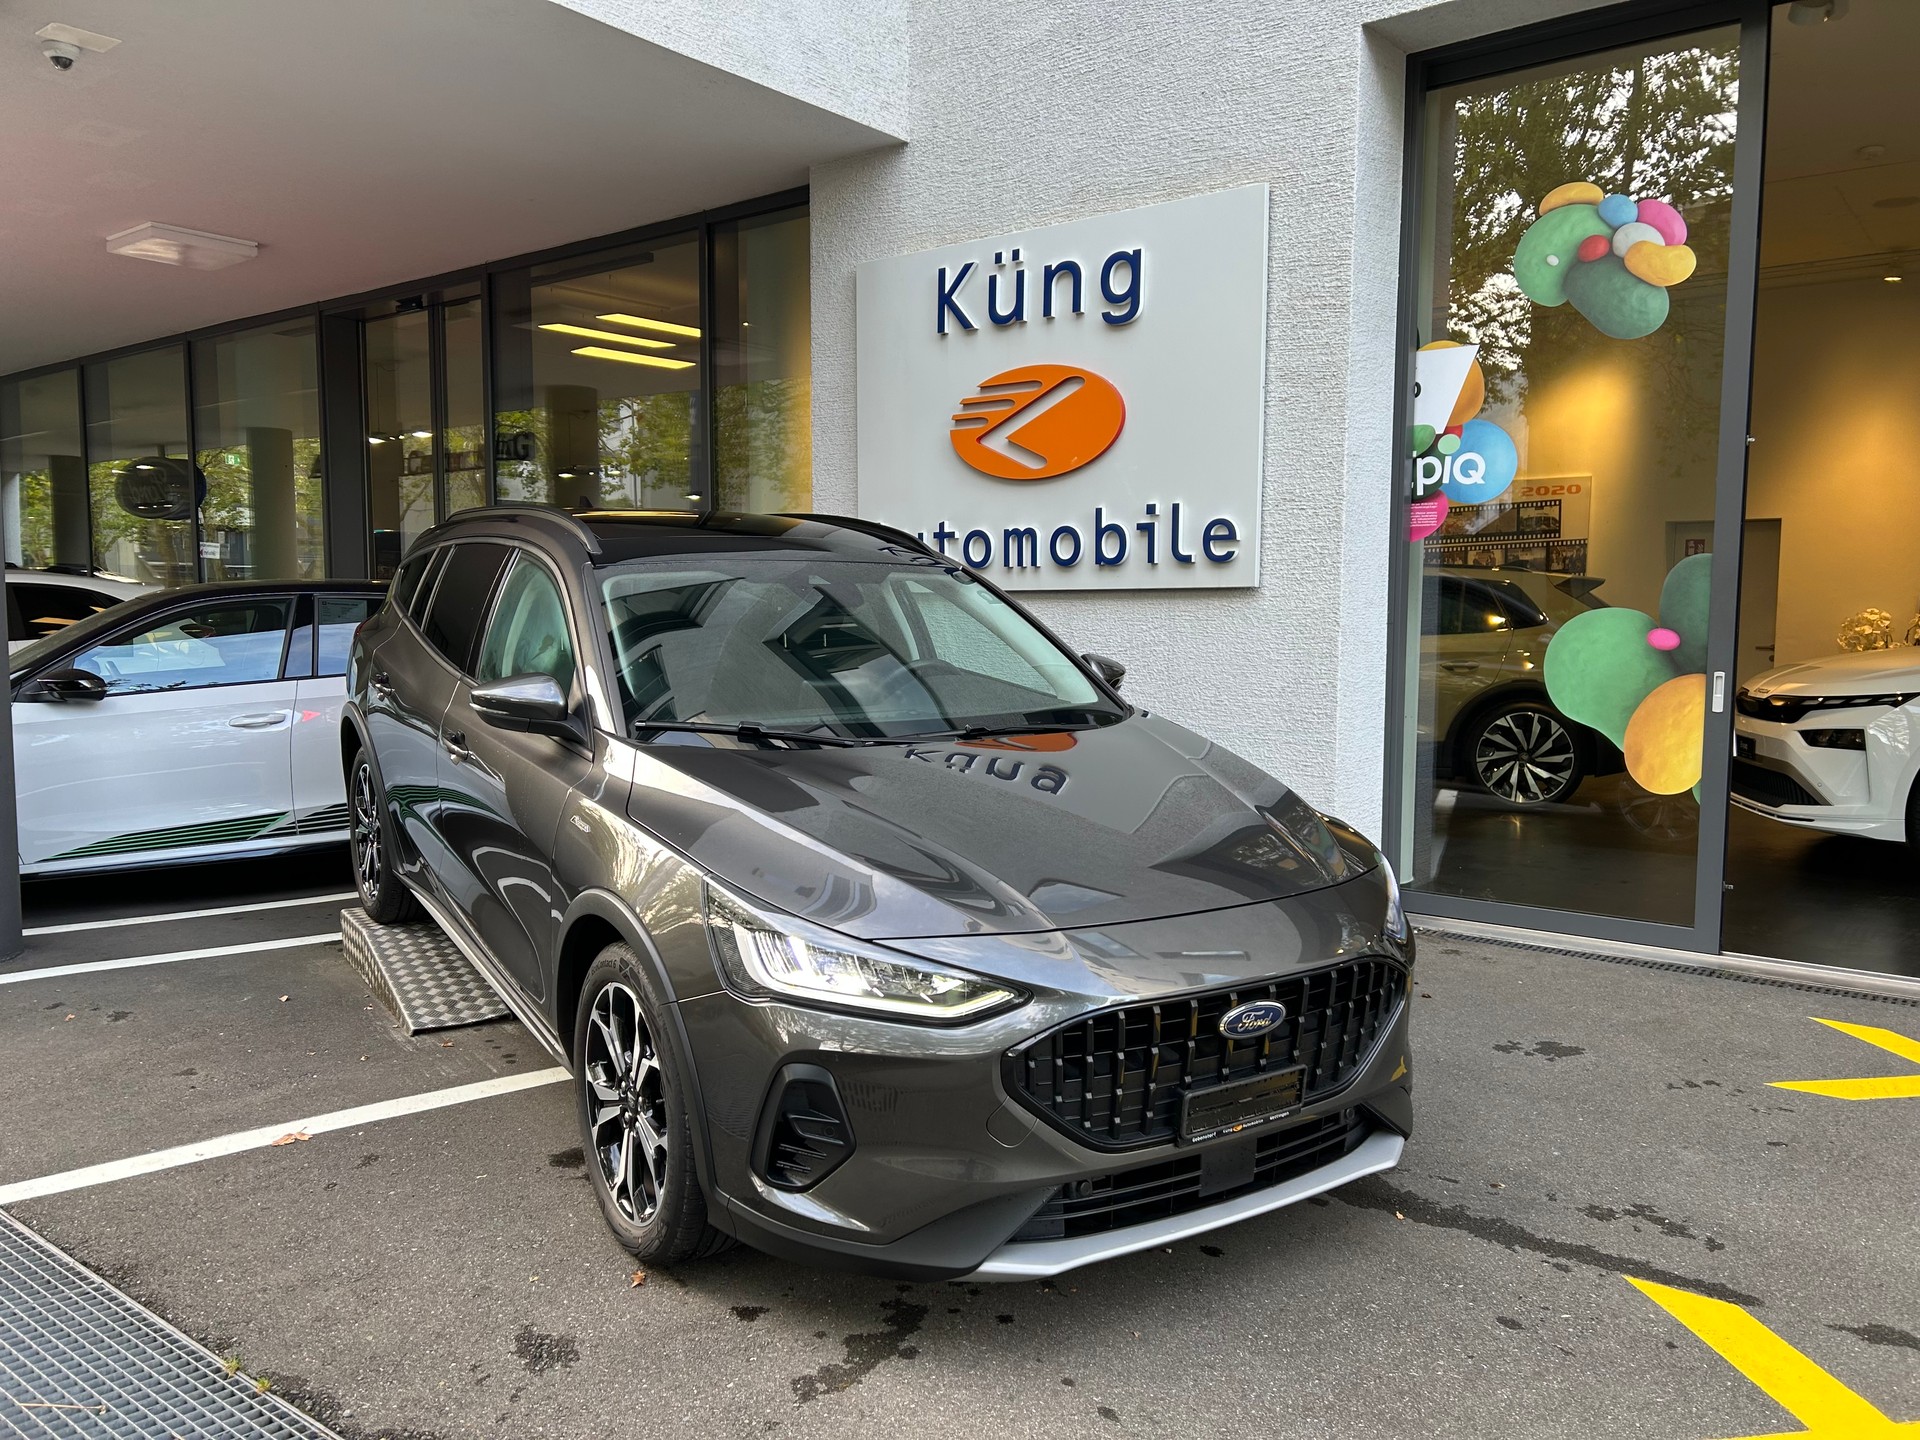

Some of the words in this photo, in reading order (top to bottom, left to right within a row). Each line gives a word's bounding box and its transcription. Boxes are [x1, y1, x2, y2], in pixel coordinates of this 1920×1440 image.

[936, 247, 1145, 335] Küng
[1411, 451, 1486, 496] piQ
[1520, 484, 1582, 498] 2020
[917, 503, 1240, 569] tomobile
[1237, 1010, 1273, 1033] Ford
